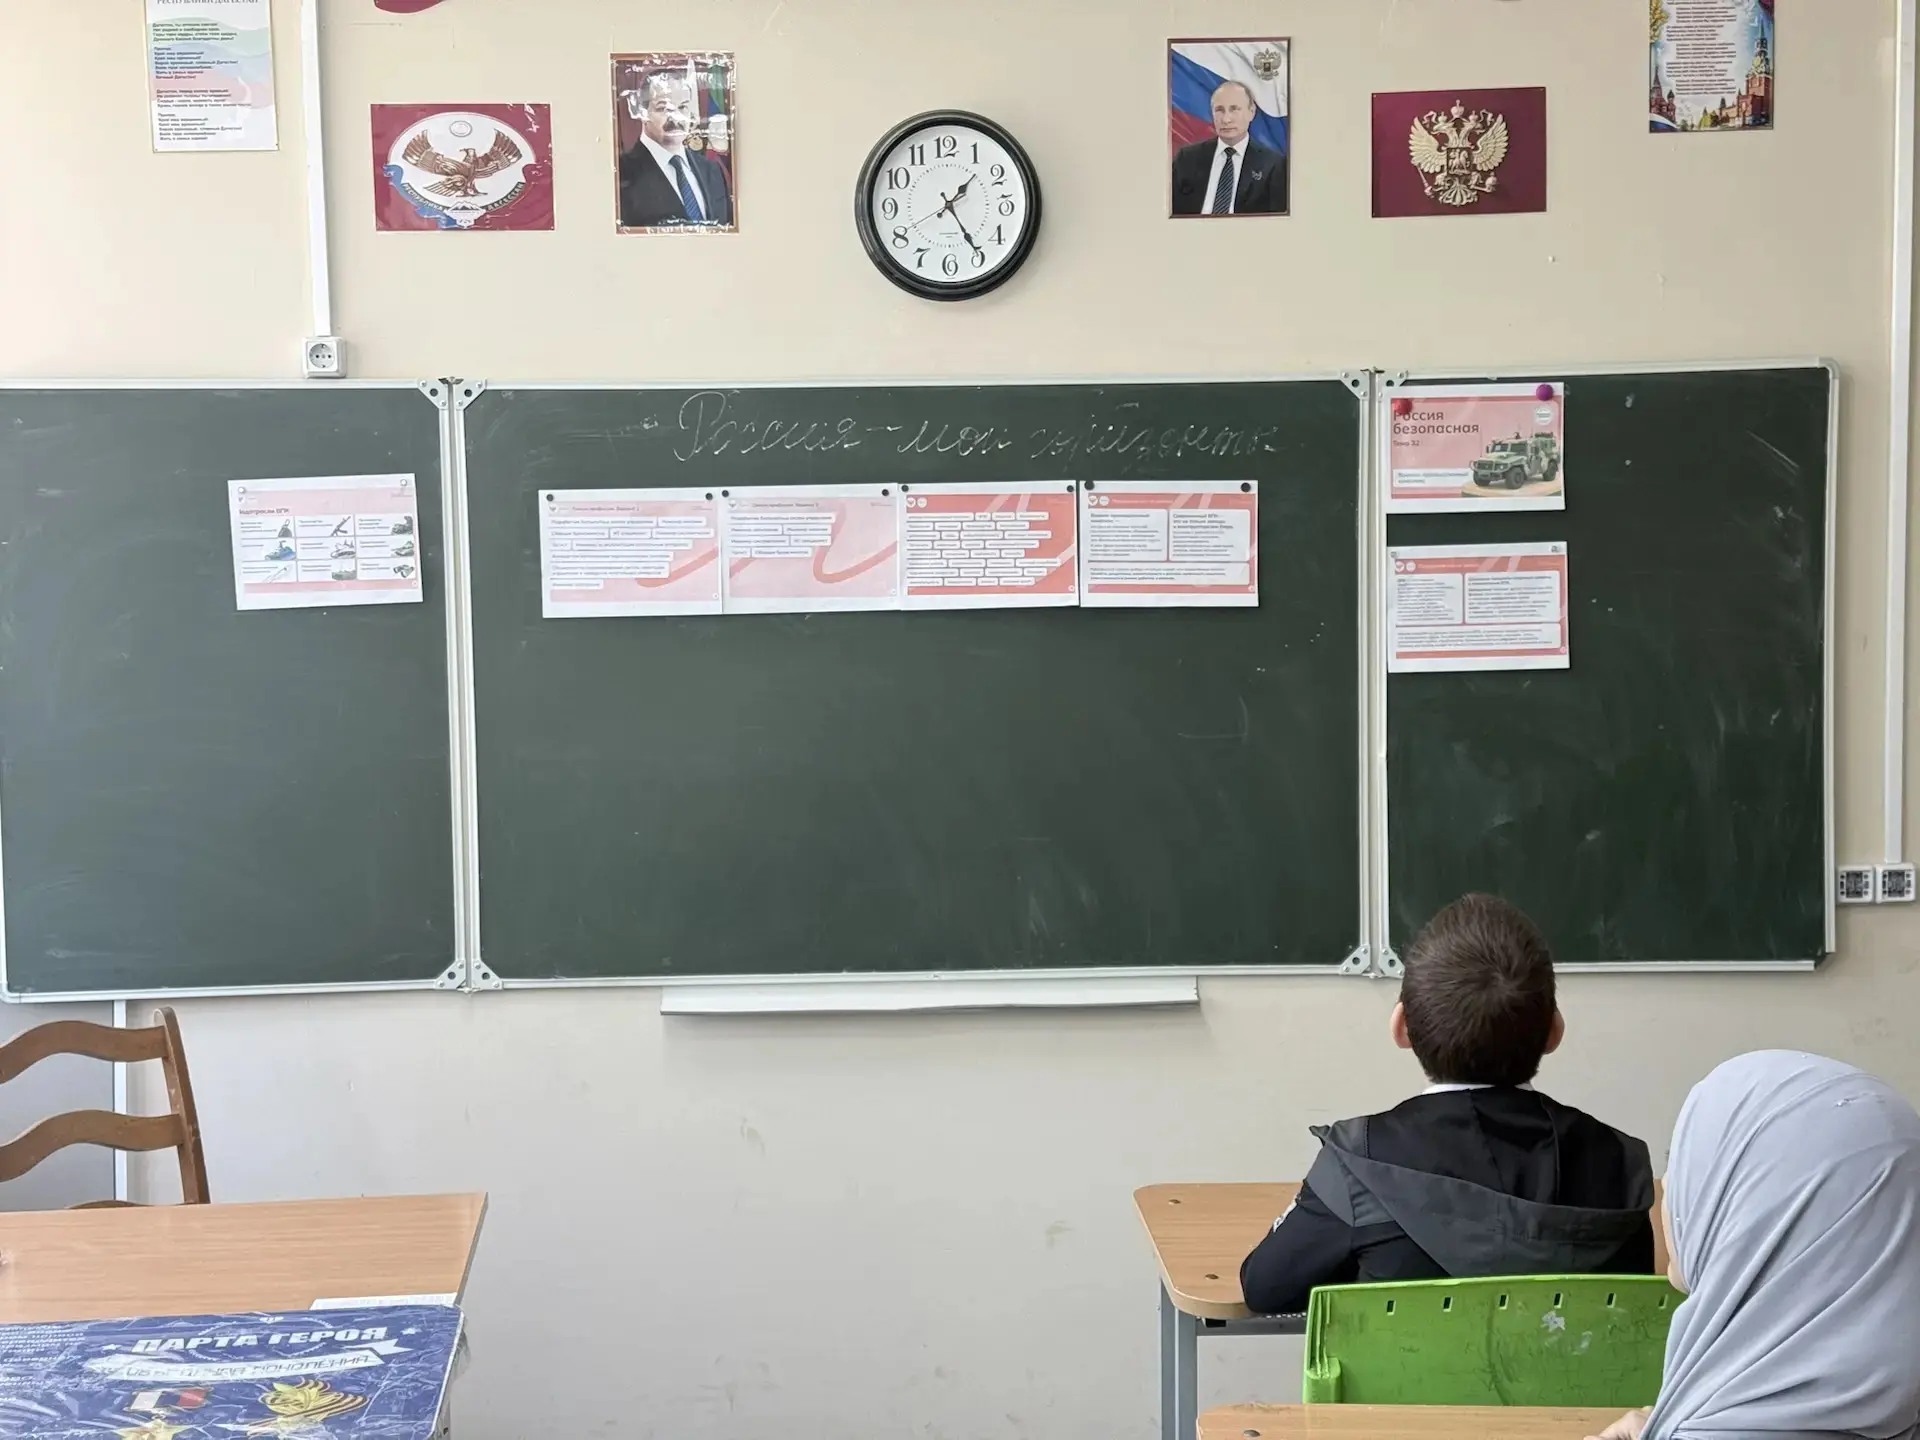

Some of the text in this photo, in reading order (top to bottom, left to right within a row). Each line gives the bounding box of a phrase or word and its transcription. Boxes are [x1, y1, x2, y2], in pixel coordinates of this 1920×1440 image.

[908, 143, 926, 166] 11
[934, 135, 959, 159] 12
[970, 142, 980, 164] 1
[886, 166, 910, 190] 10
[990, 164, 1007, 186] 2
[882, 197, 898, 220] 9
[997, 193, 1015, 216] 3
[892, 225, 909, 249] 8
[988, 224, 1006, 245] 4
[913, 247, 931, 269] 7
[941, 253, 958, 277] 6
[970, 245, 986, 268] 5
[1393, 409, 1444, 421] Россия
[1393, 422, 1479, 435] безопасная
[131, 1327, 388, 1353] ПАРТА ГЕРОЯ
